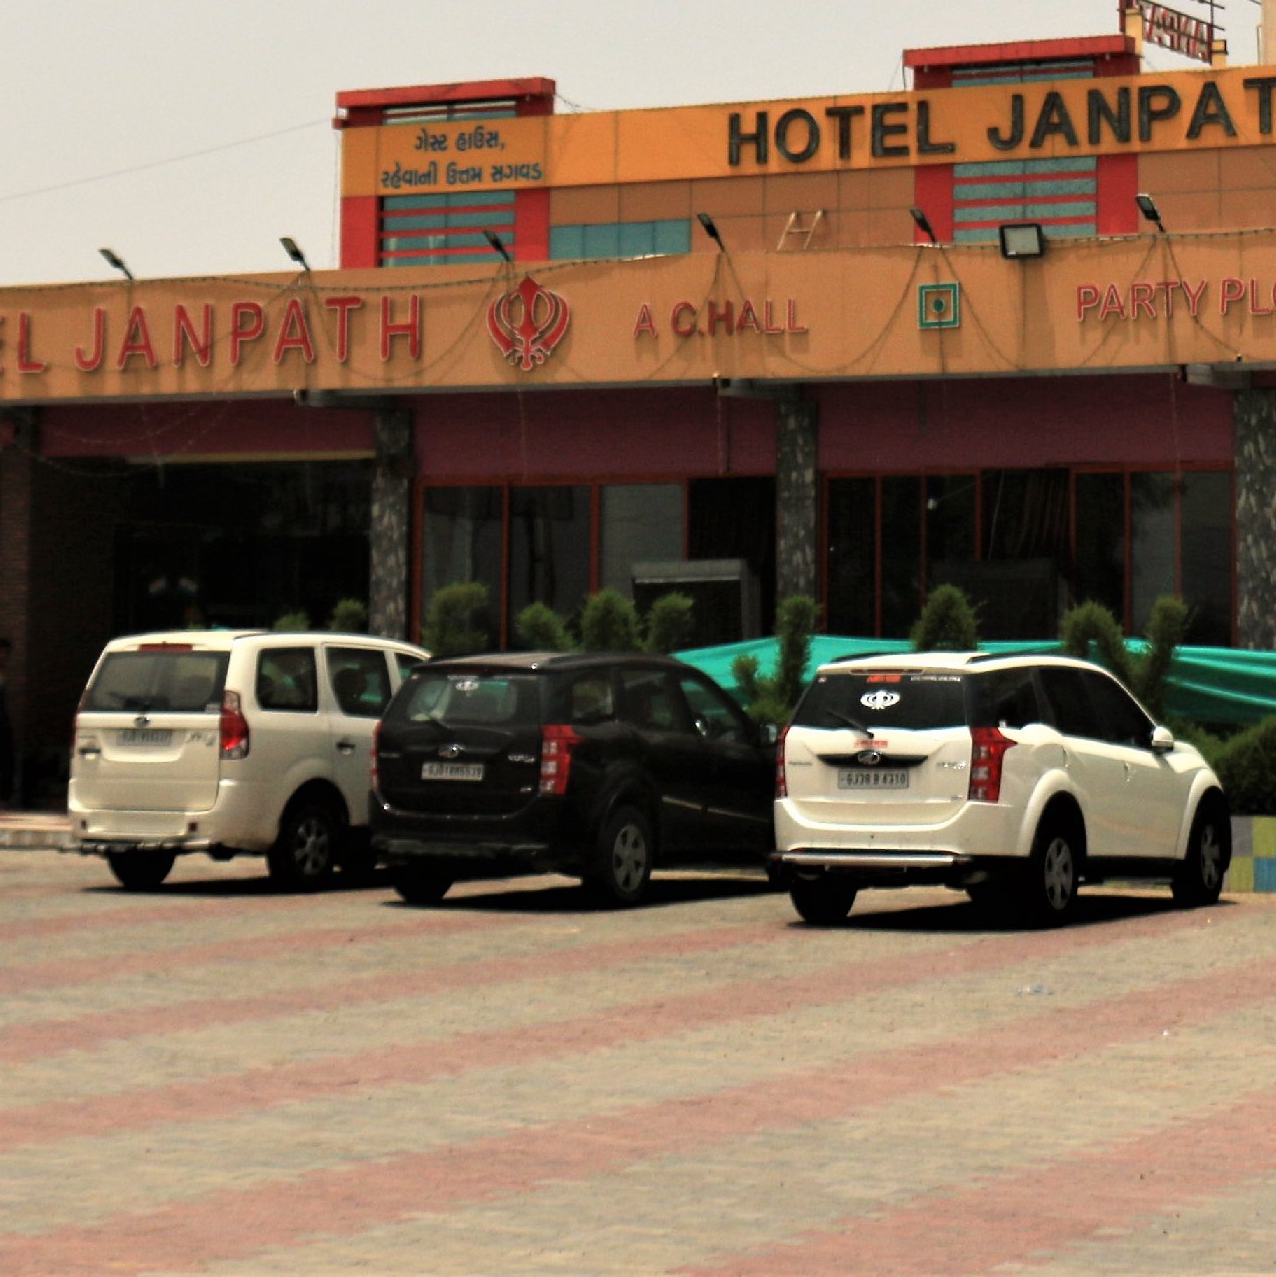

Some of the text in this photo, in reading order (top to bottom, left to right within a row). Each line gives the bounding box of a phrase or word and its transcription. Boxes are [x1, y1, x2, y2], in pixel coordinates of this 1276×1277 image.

[728, 99, 956, 167] HOTEL
[633, 302, 659, 339] A
[1075, 278, 1209, 322] PARTY
[74, 291, 424, 372] JANPATH
